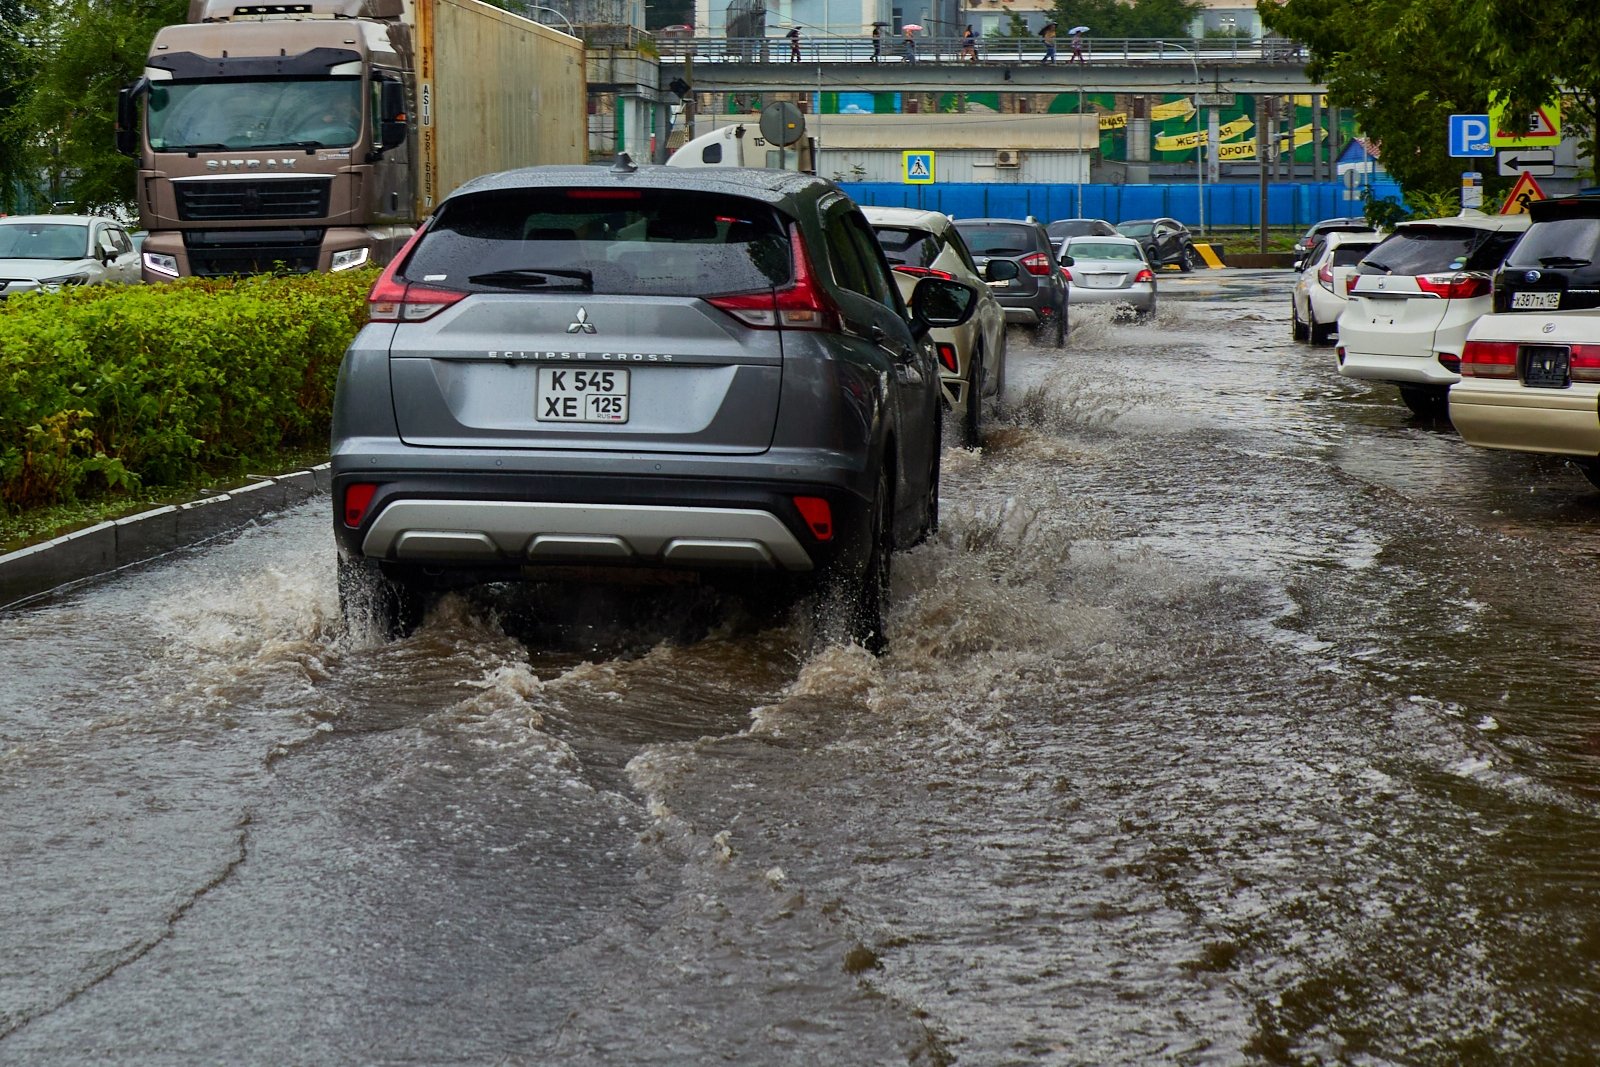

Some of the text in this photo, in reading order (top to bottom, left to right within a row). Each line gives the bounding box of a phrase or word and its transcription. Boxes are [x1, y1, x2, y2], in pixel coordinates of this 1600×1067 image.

[1462, 120, 1487, 152] P
[1219, 144, 1254, 157] ОРОГА
[206, 158, 297, 170] SITRAK
[488, 351, 673, 362] ECLIPSE CROSS
[574, 371, 615, 392] 545
[591, 397, 622, 413] 125
